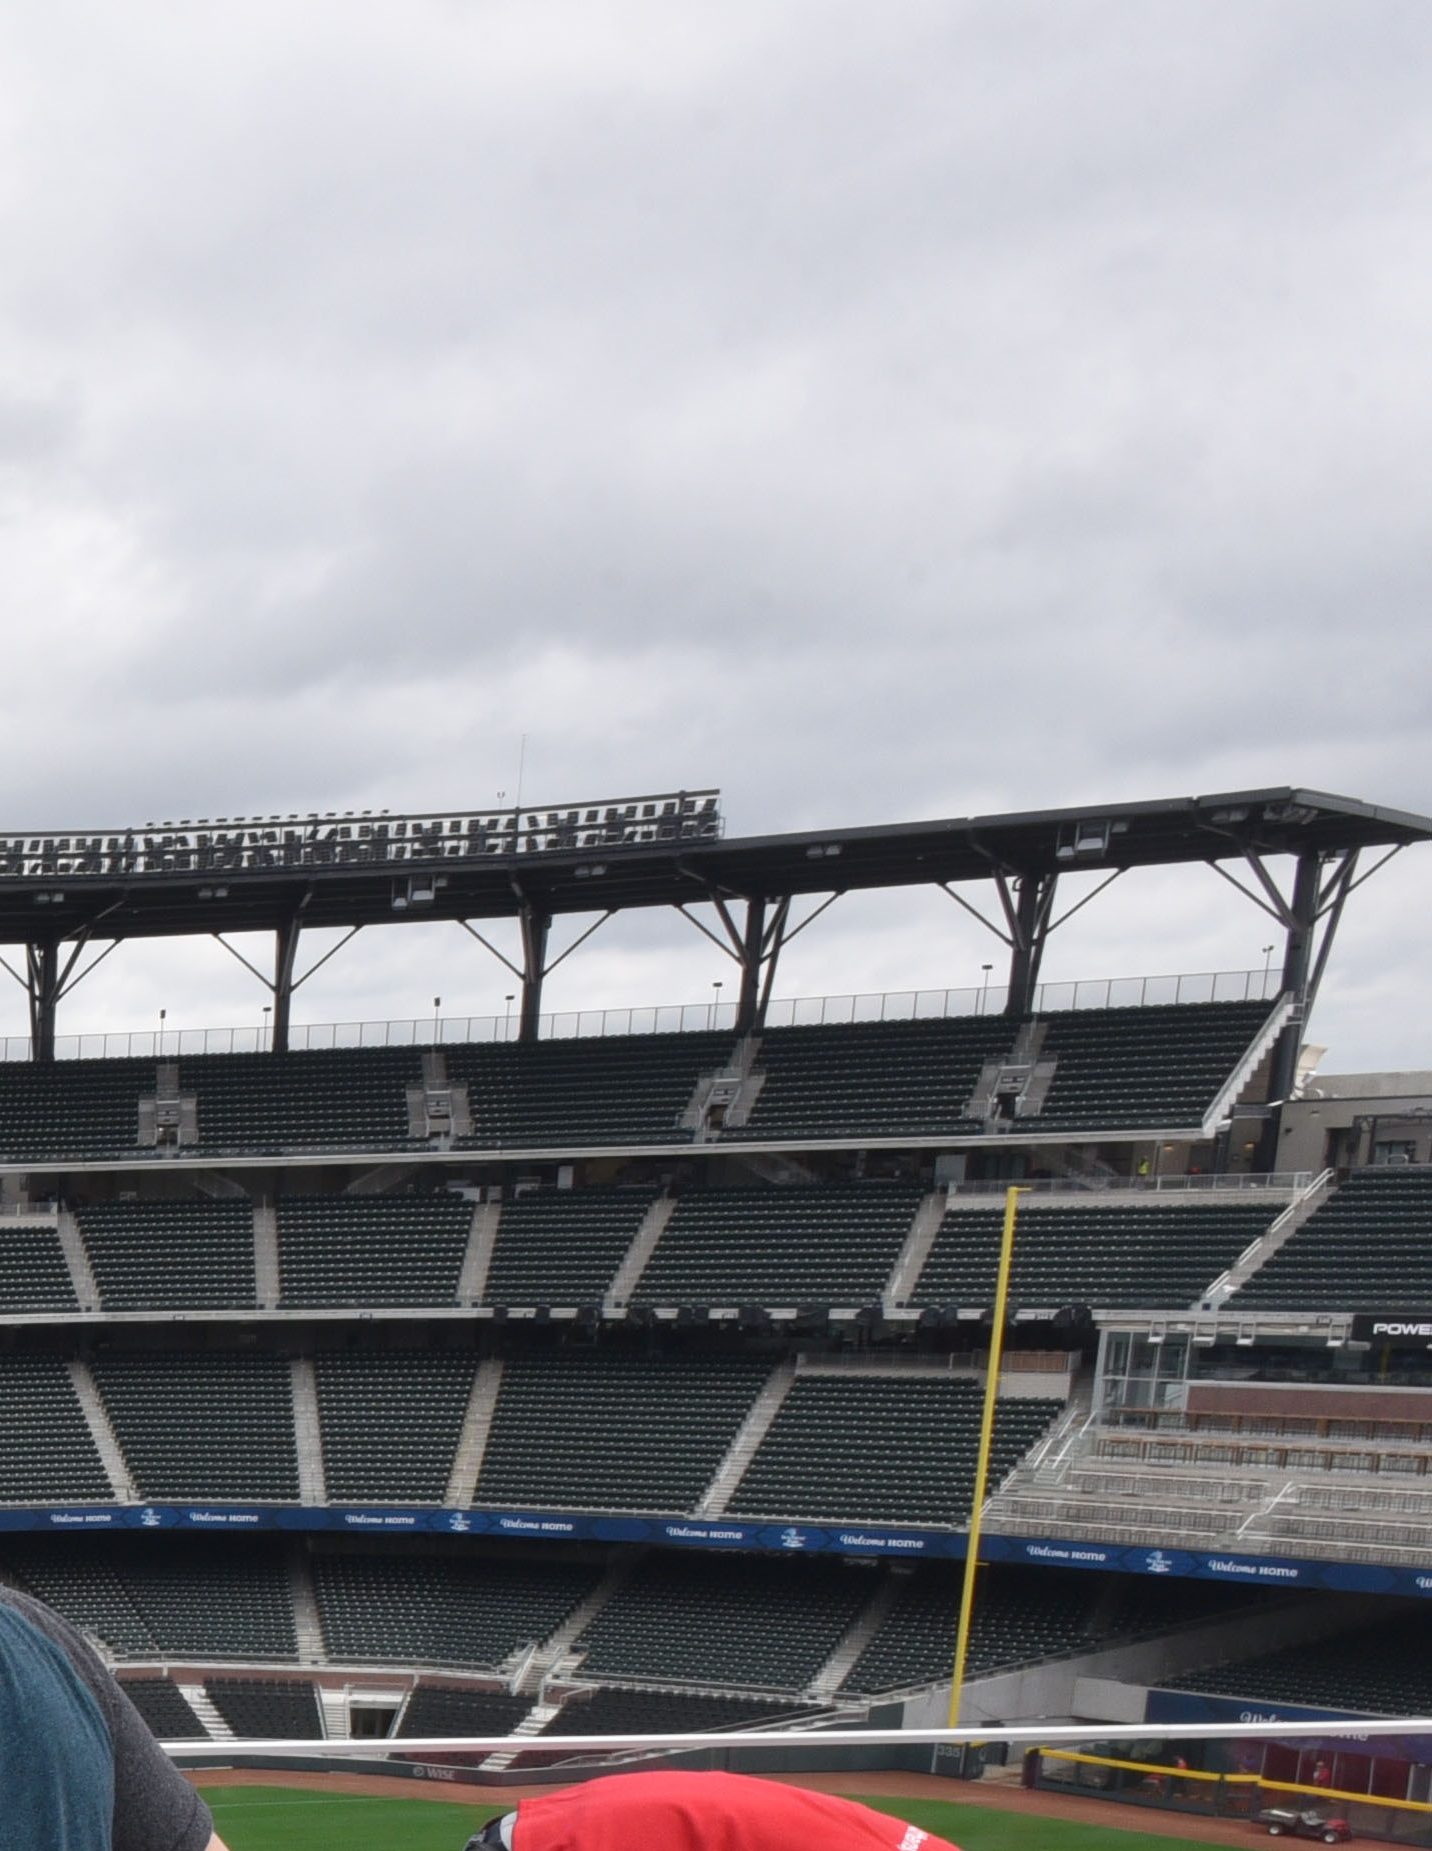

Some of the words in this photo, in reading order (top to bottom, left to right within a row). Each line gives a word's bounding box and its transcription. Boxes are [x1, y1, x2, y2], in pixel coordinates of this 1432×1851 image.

[840, 1534, 886, 1547] Welcome
[1026, 1544, 1069, 1558] Welcome
[1208, 1560, 1257, 1574] Welcome
